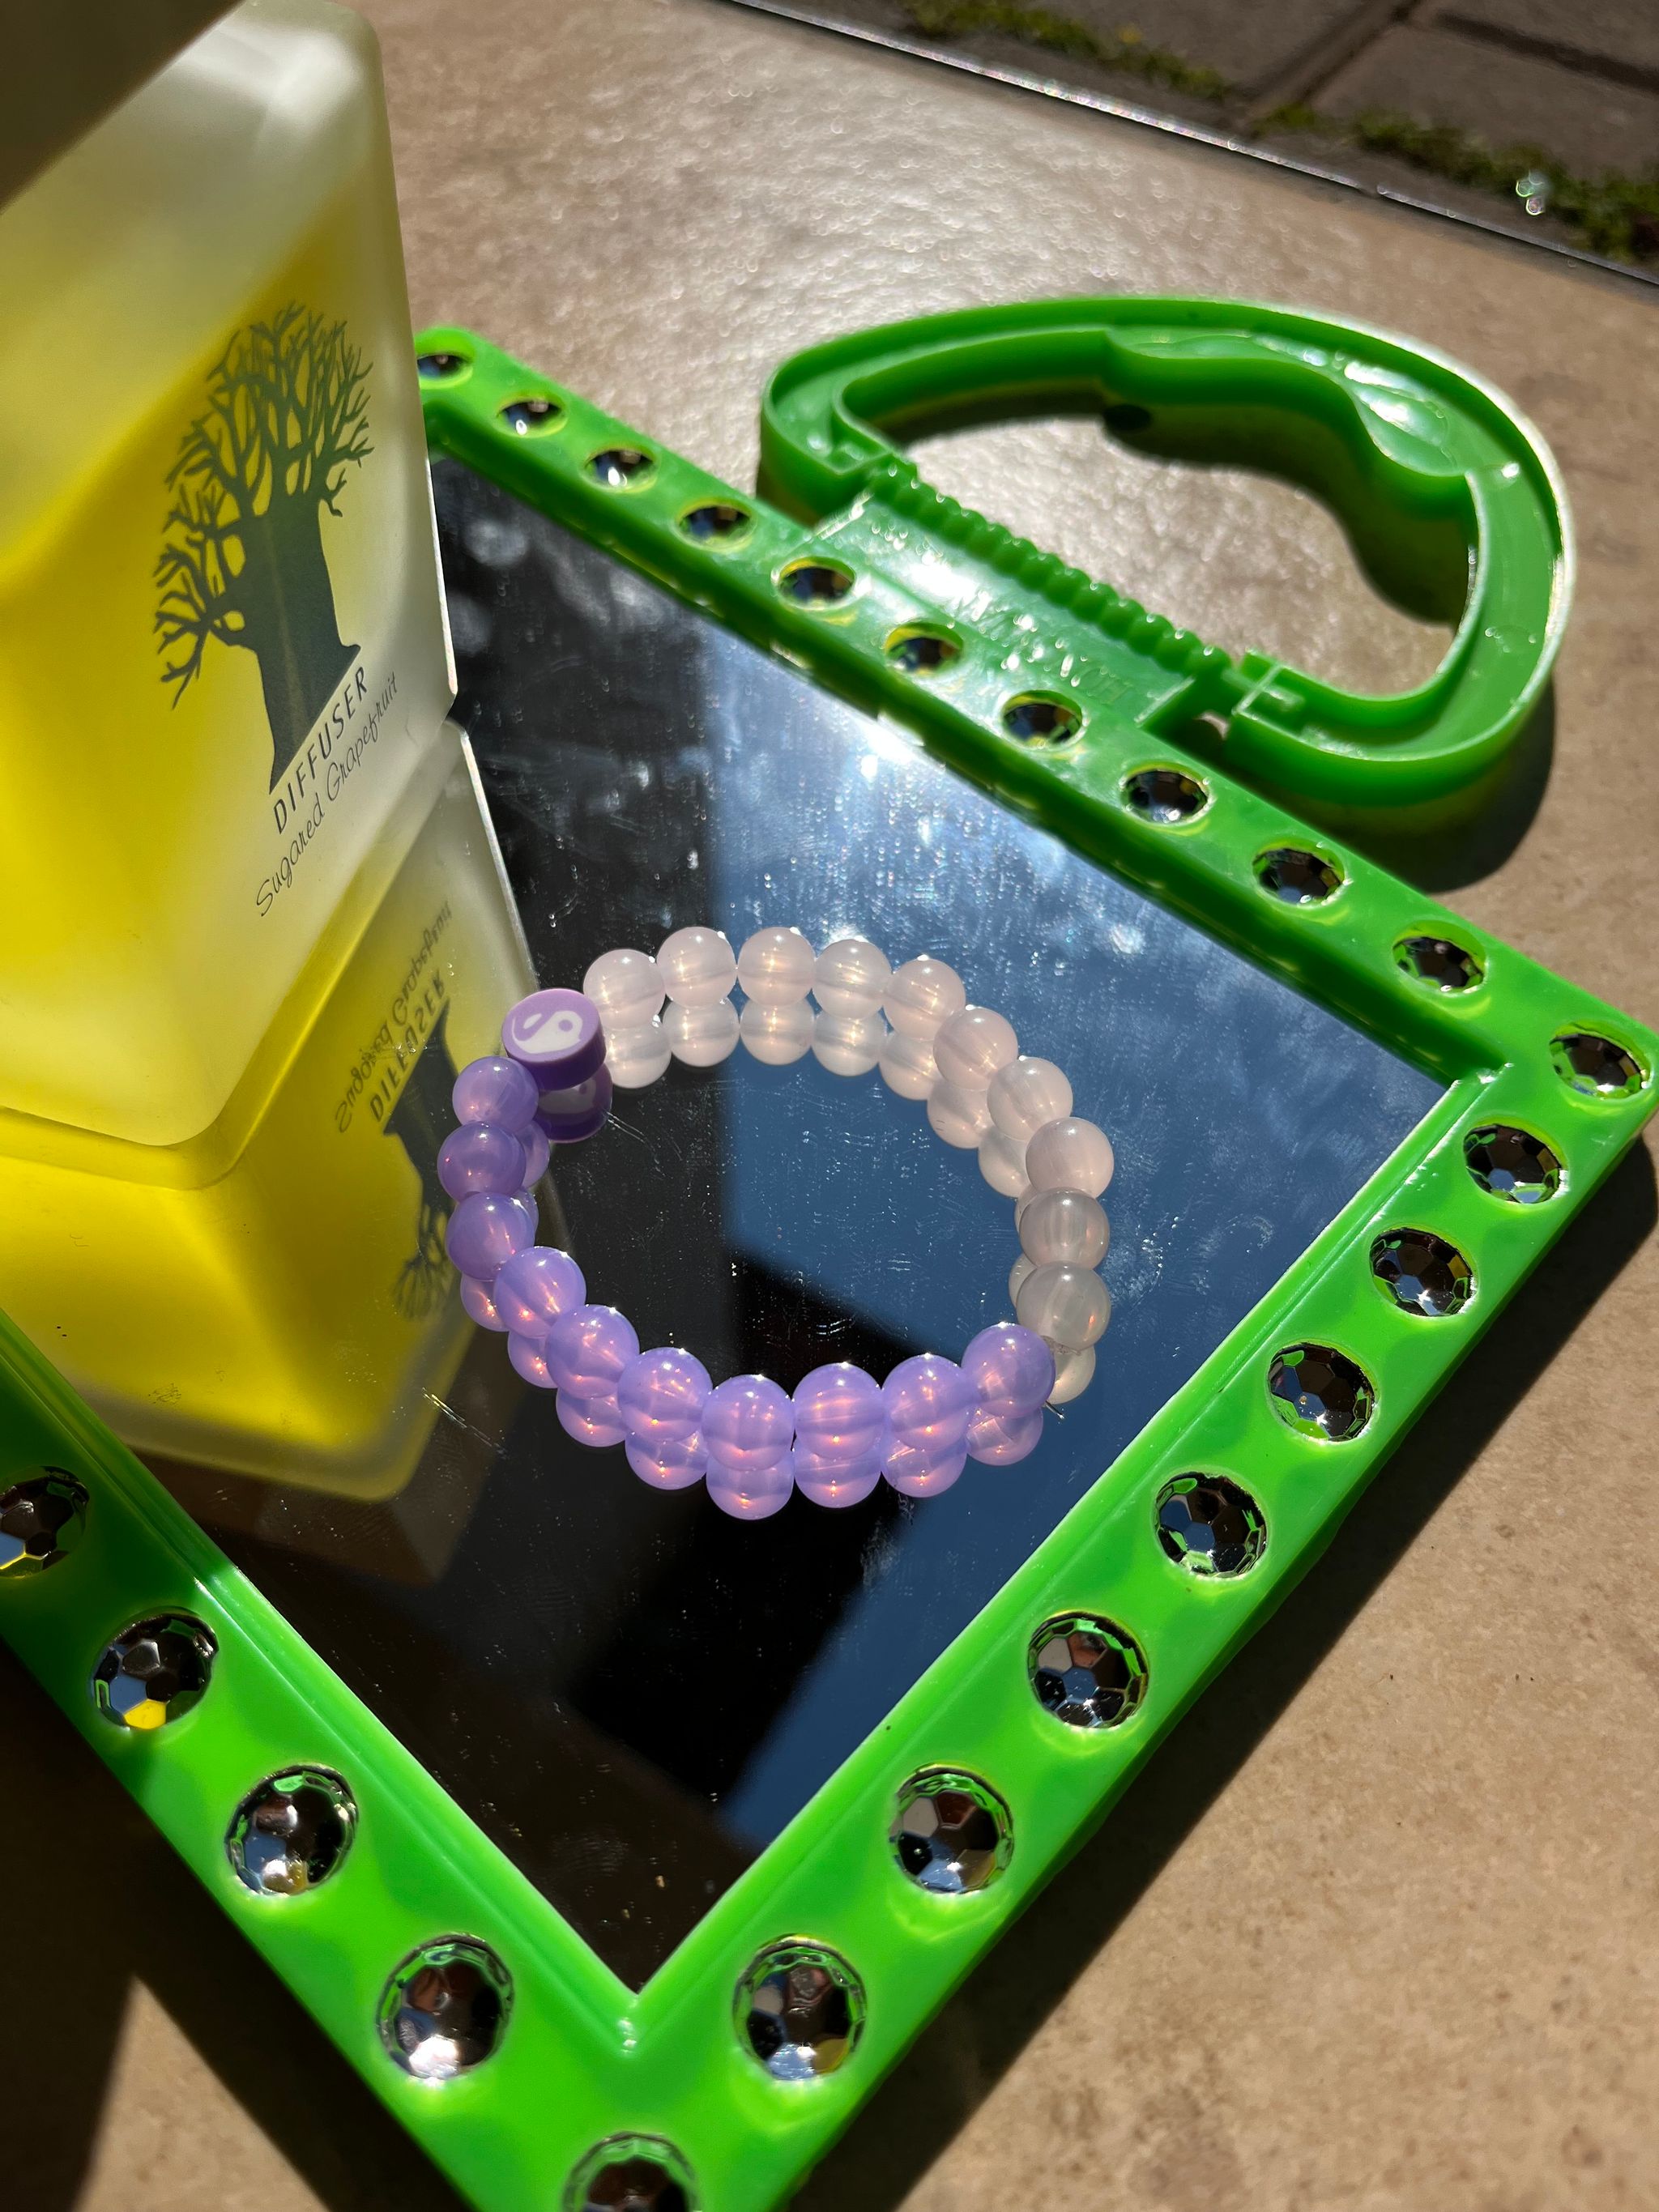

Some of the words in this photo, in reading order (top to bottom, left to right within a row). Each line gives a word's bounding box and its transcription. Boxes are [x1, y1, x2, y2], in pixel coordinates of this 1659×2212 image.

[256, 792, 325, 917] Sugared
[326, 671, 398, 802] Grapefruit
[273, 666, 367, 834] DIFFUSER
